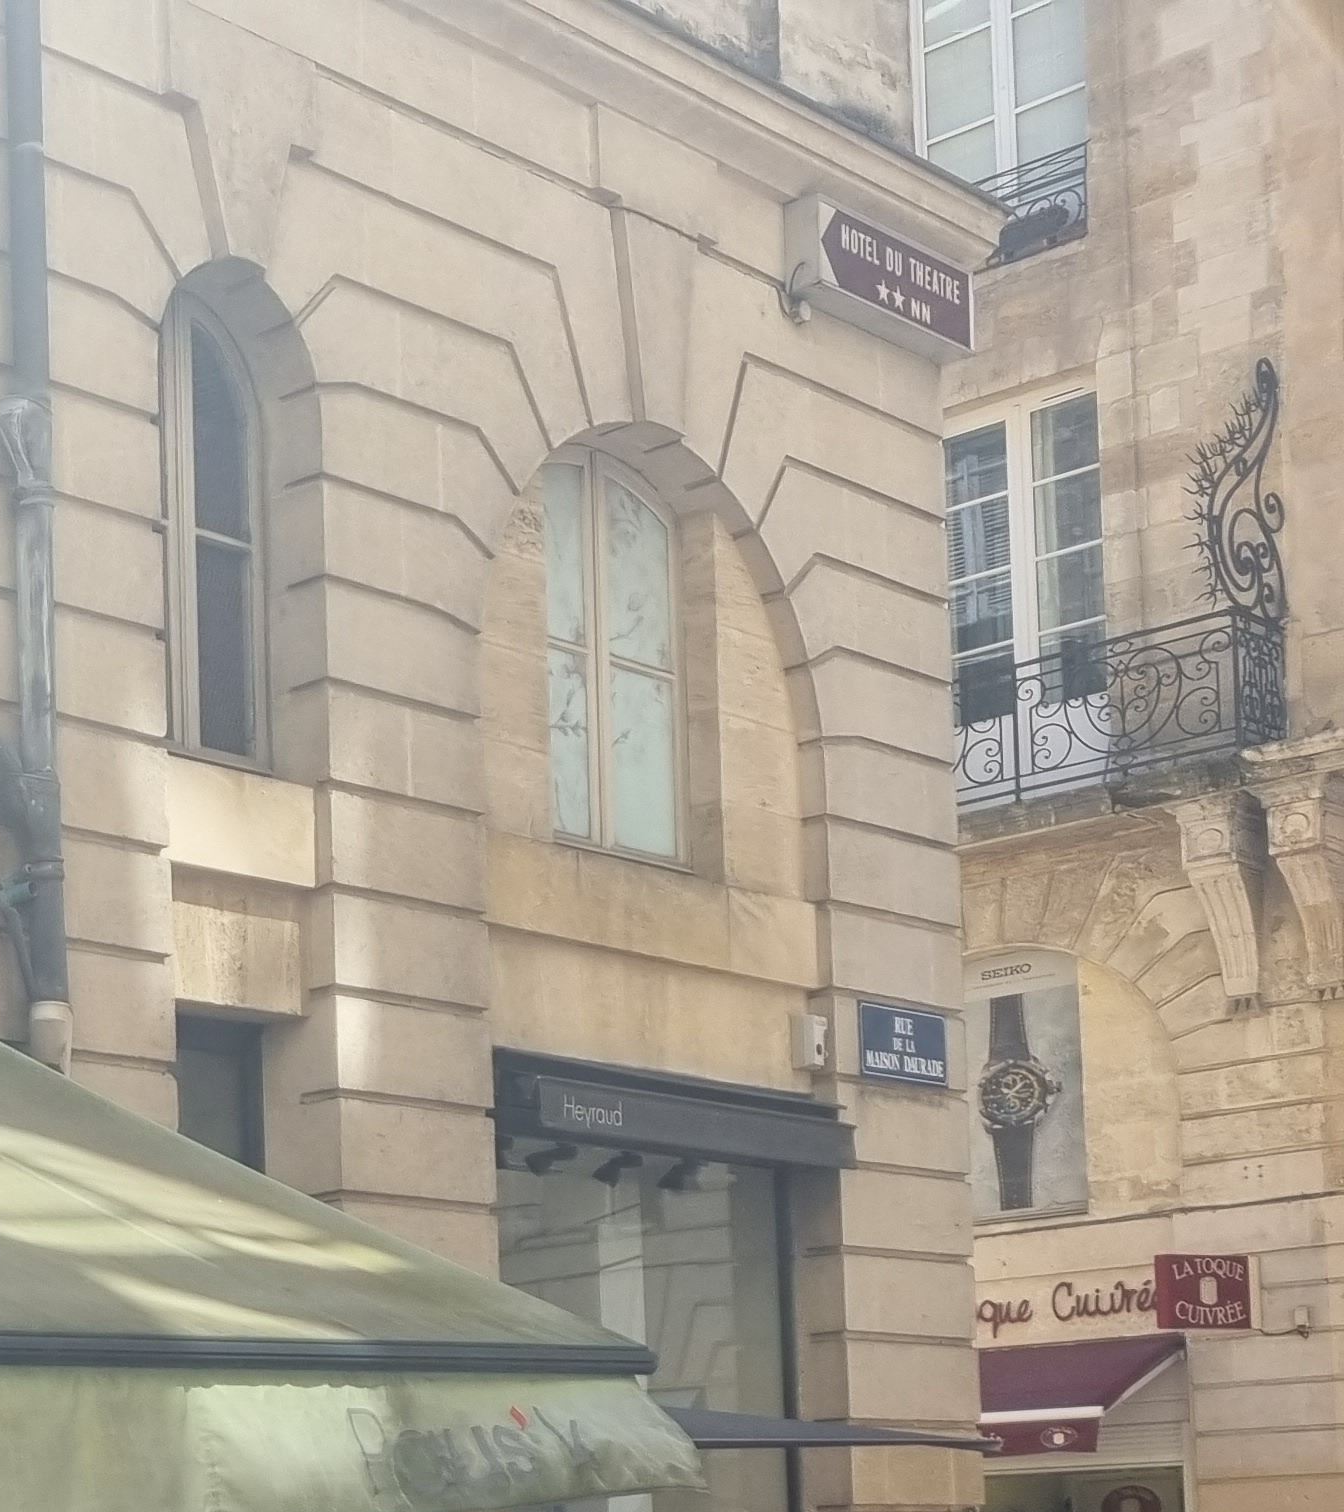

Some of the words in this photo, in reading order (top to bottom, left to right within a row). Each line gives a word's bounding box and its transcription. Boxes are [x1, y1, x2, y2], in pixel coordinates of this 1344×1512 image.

[840, 223, 880, 266] HOTEL
[885, 246, 904, 277] DU
[909, 257, 962, 305] THEATRE
[911, 300, 932, 325] NN
[980, 963, 1032, 981] SEIKO
[894, 1016, 914, 1036] RUE
[893, 1037, 903, 1051] DE
[906, 1038, 916, 1053] LA
[865, 1050, 901, 1071] MAISON
[904, 1055, 945, 1078] DAURADE
[563, 1094, 623, 1129] Heyraud
[1172, 1263, 1194, 1281] LA
[1194, 1257, 1245, 1281] TOQUE
[976, 1297, 1034, 1338] que
[1175, 1299, 1247, 1326] CUIVRÉE
